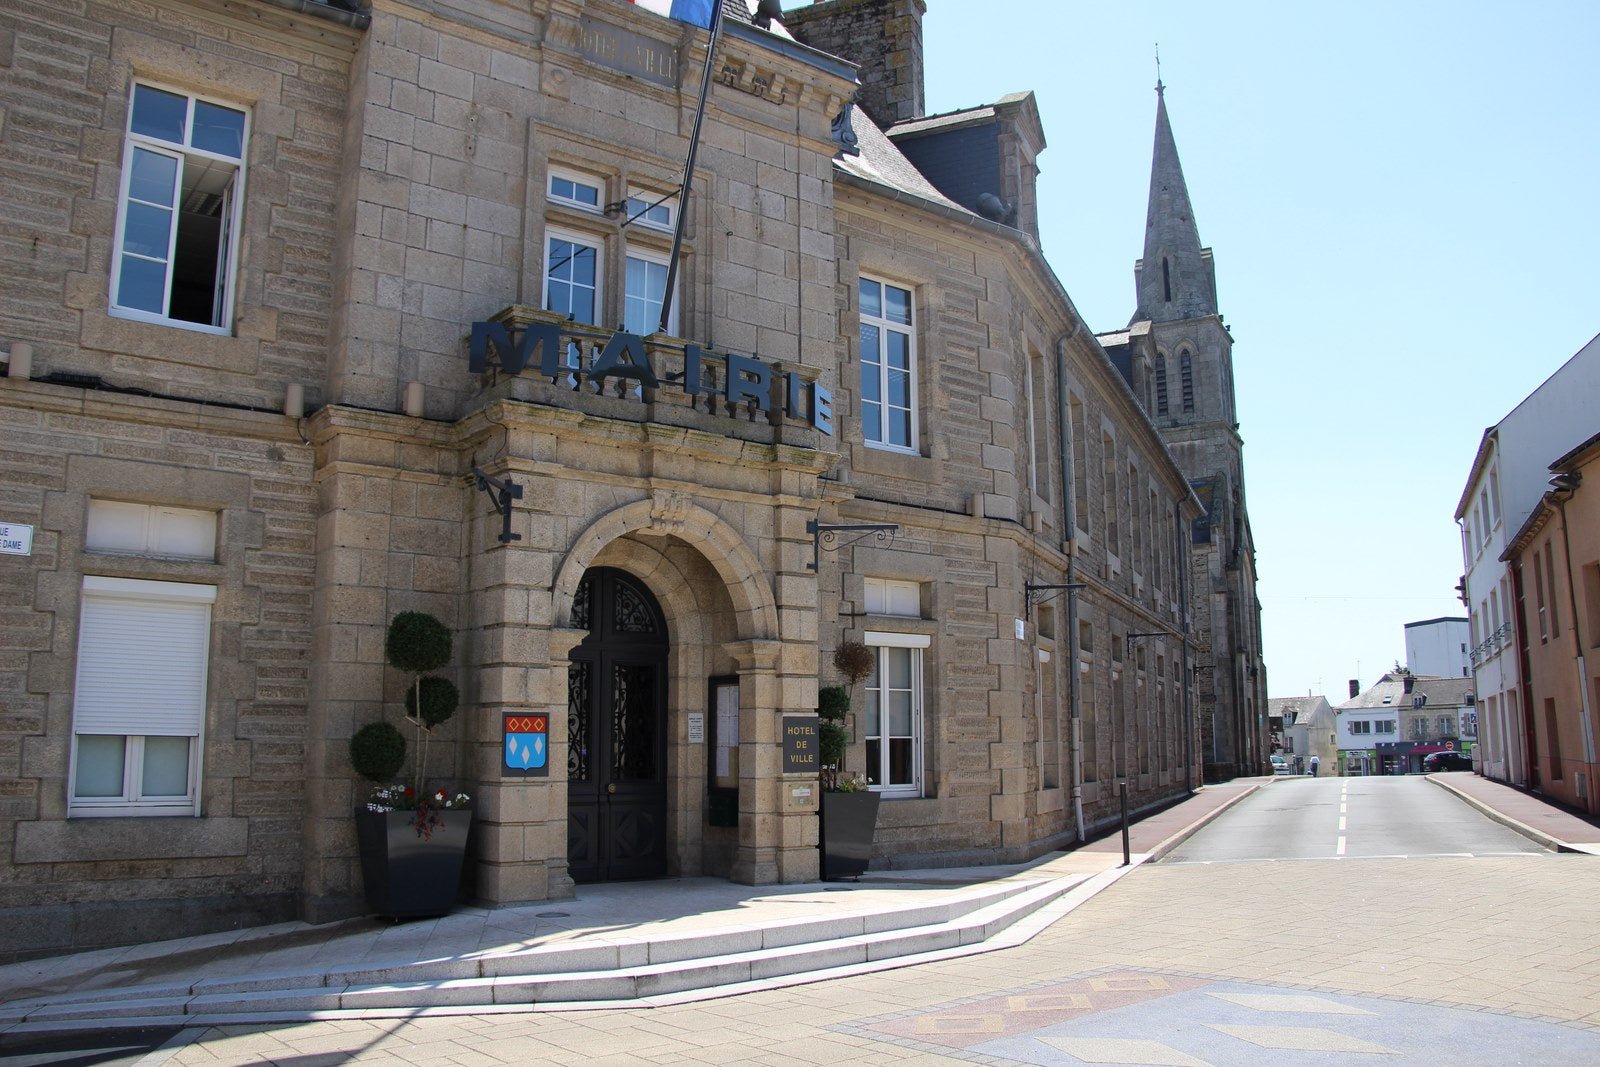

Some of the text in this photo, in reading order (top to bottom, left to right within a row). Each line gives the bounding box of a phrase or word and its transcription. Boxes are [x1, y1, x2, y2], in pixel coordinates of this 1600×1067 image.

[469, 321, 833, 436] MAIRIE
[2, 539, 22, 550] DAME
[787, 726, 816, 735] HOTEL
[796, 740, 807, 749] DE
[790, 754, 814, 763] VILLE
